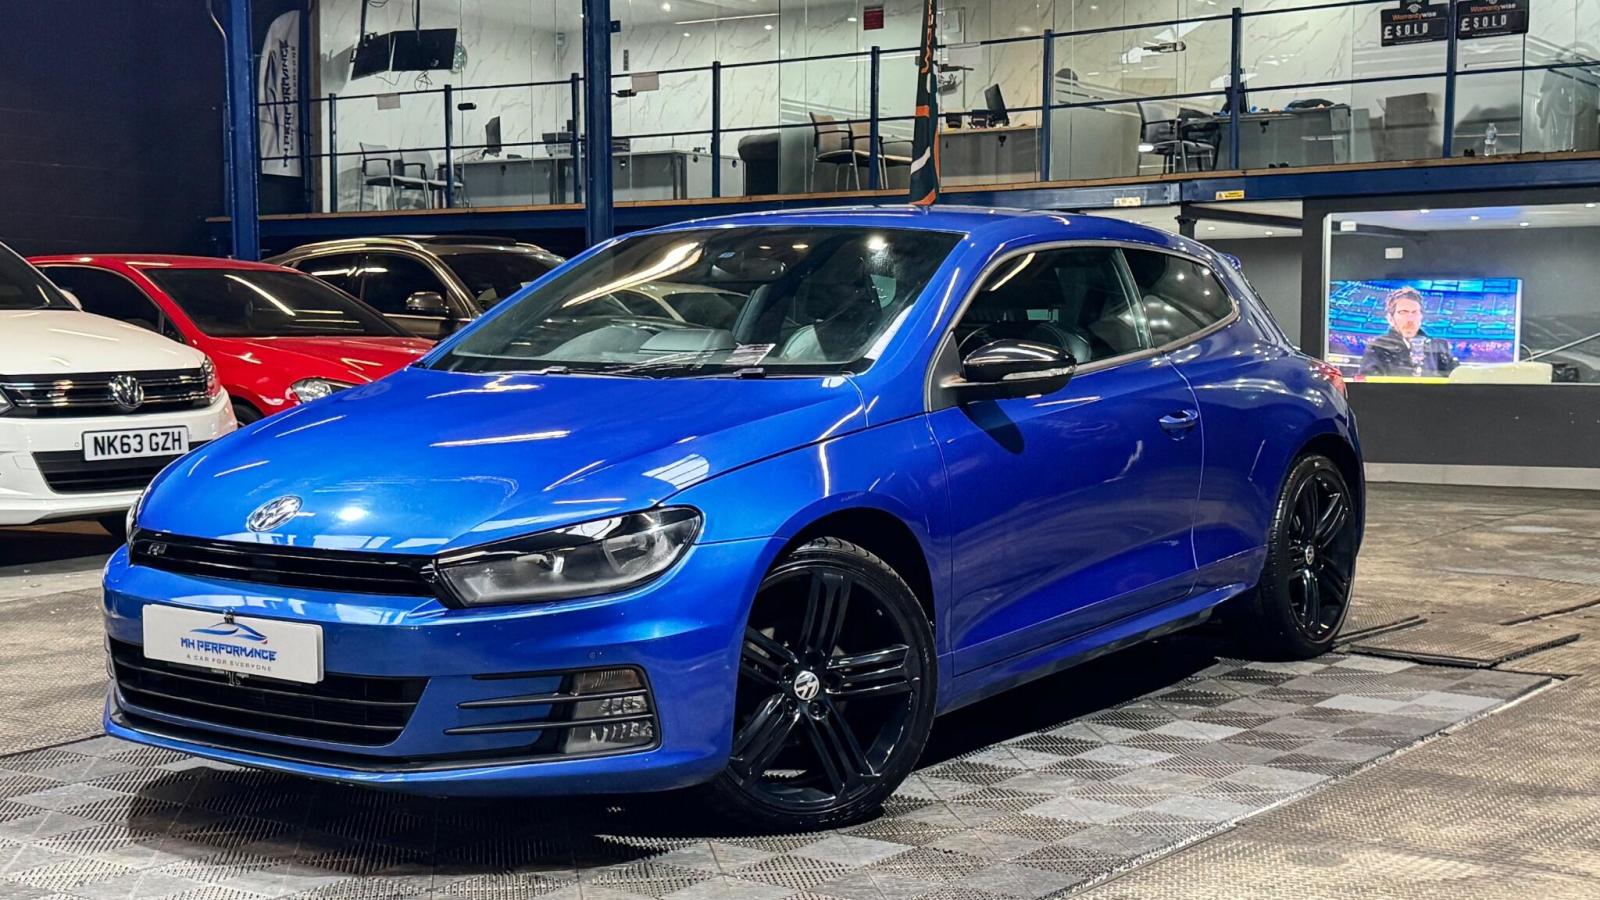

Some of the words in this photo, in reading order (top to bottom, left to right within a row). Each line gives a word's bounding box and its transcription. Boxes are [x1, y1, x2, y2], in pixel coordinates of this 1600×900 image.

[93, 434, 144, 456] NK63
[149, 431, 182, 452] GZH
[180, 637, 195, 649] MH
[197, 640, 278, 661] PERFORMANCE
[212, 657, 227, 665] FOR
[229, 660, 272, 672] EVERYONE
